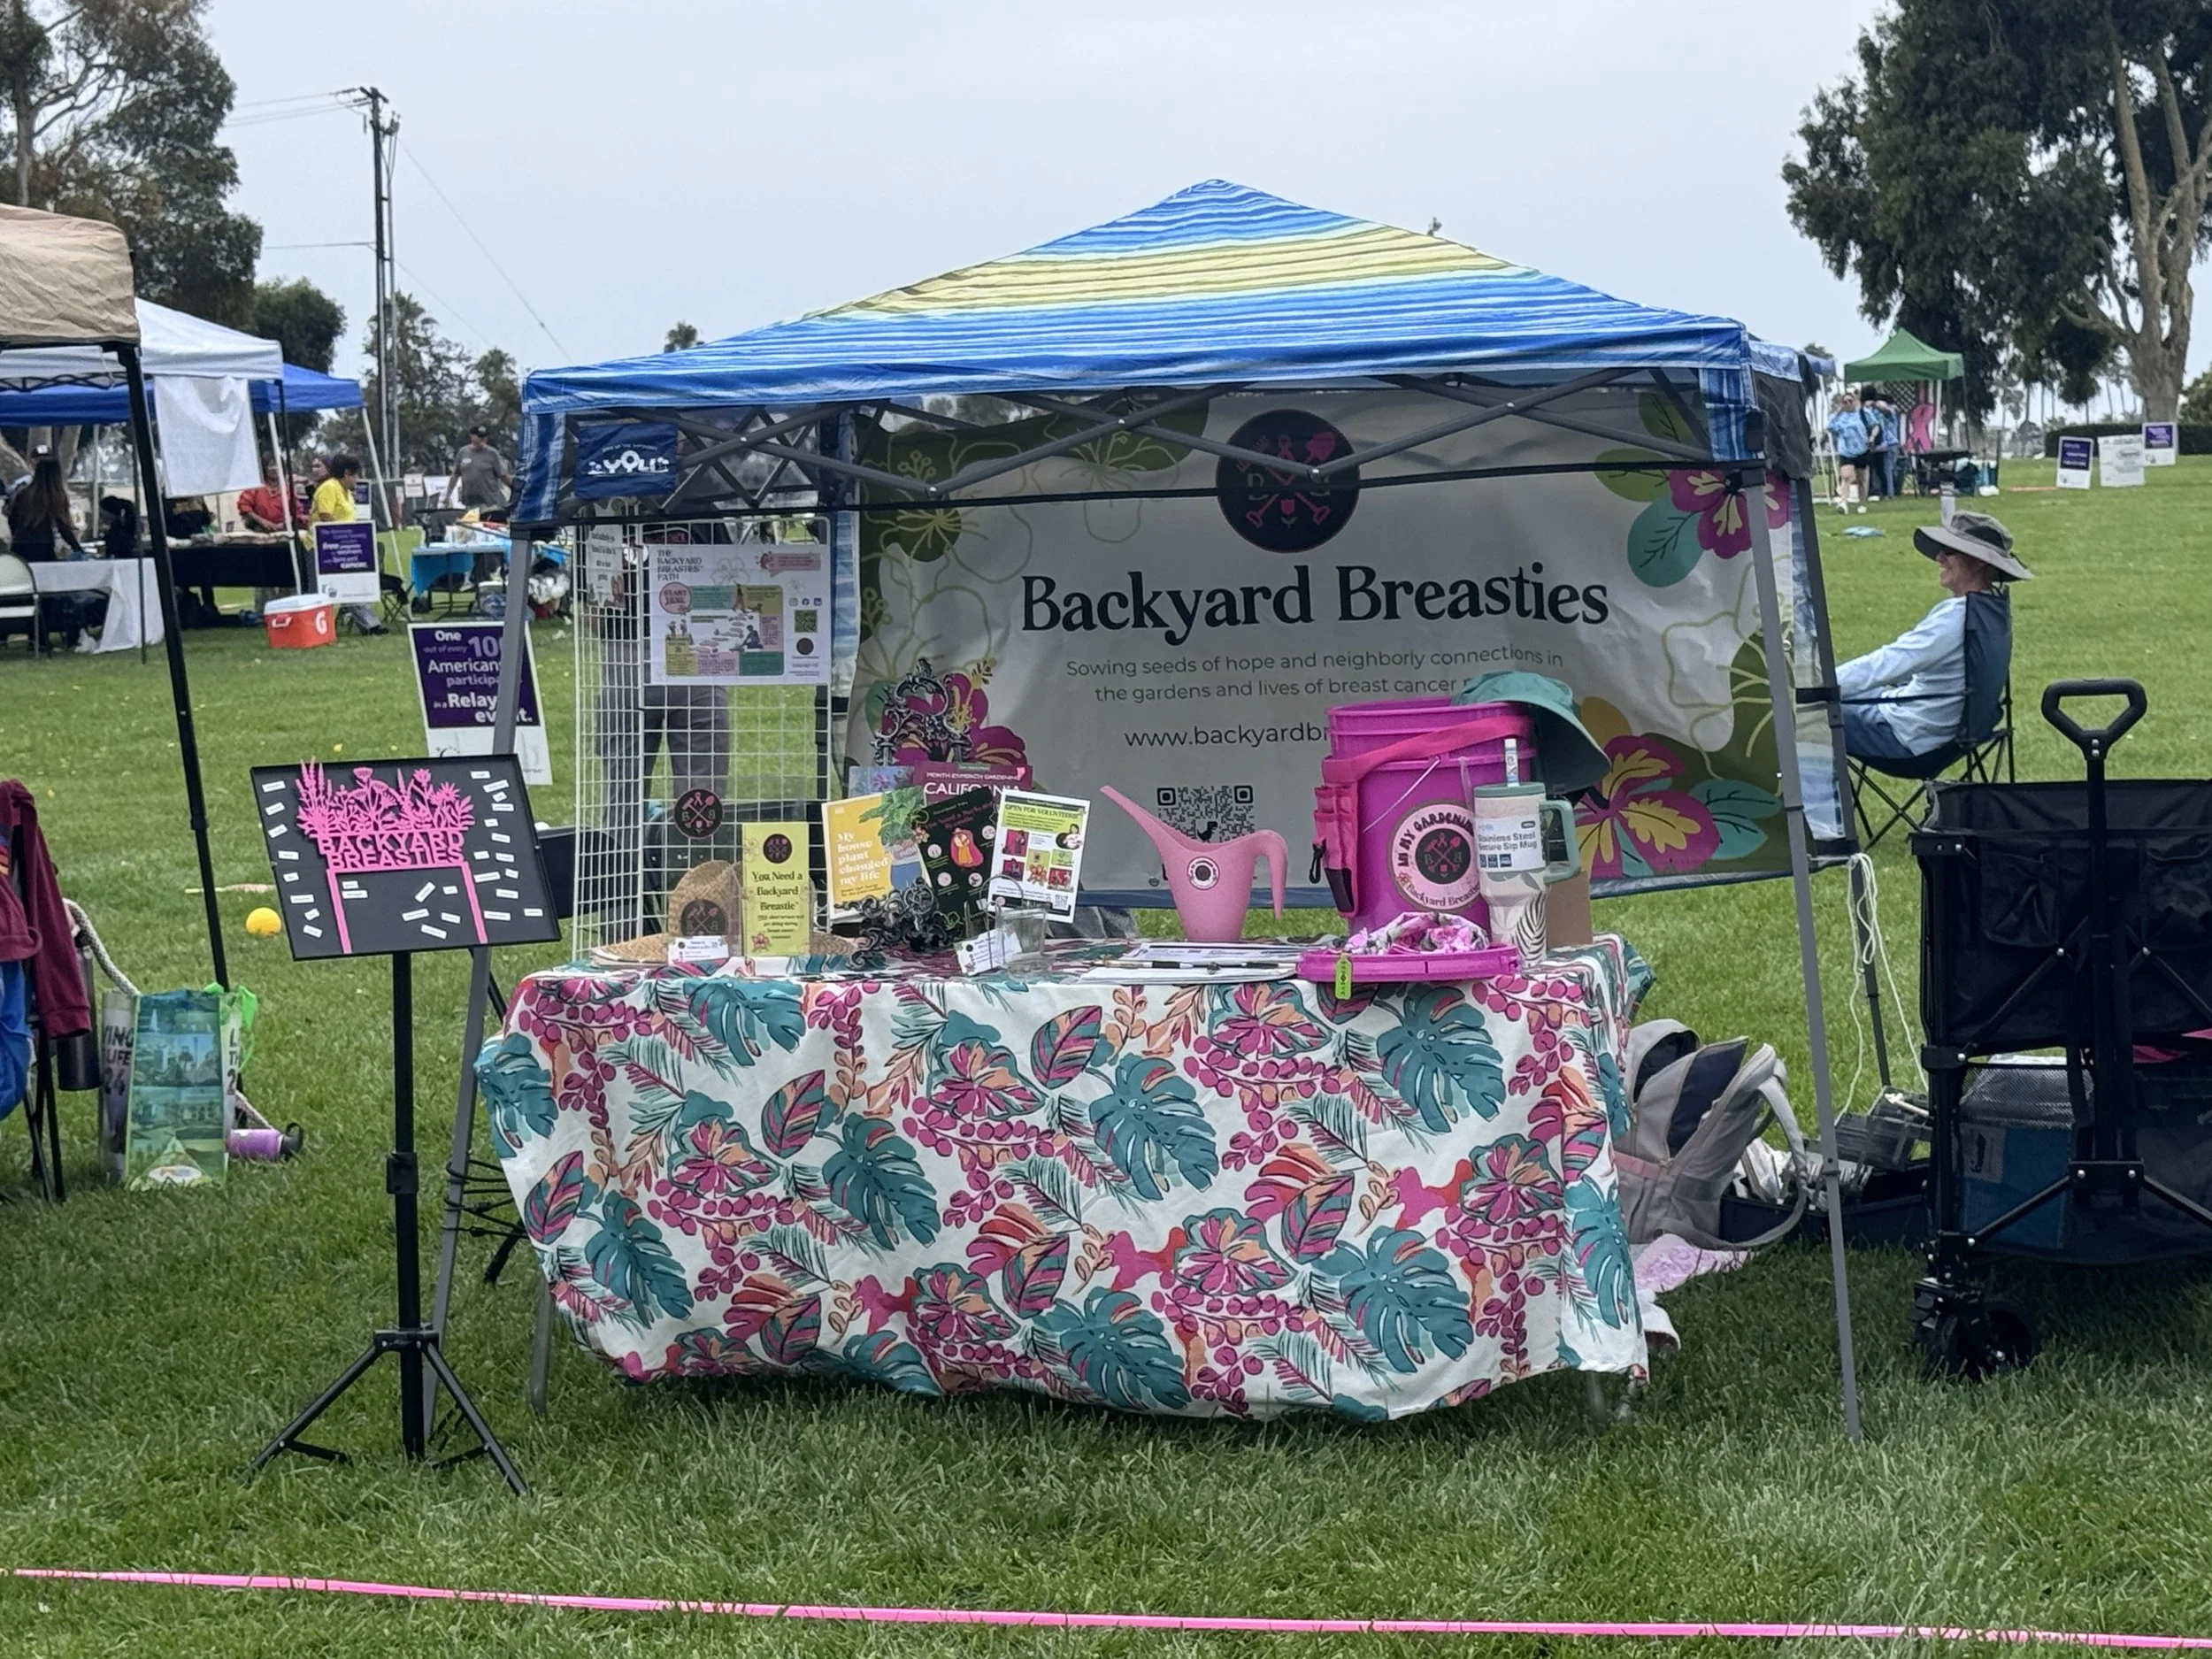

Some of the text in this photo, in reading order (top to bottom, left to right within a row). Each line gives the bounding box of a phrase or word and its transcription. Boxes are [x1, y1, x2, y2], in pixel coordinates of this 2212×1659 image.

[1021, 561, 1609, 646] Backyard Breasties
[434, 630, 462, 641] One
[468, 635, 503, 657] 10
[428, 657, 502, 674] American
[1066, 643, 1563, 678] Sowing seeds of hope and neighborly connections in
[1094, 686, 1127, 702] the
[1132, 684, 1211, 704] gardens
[1216, 680, 1254, 697] and
[1258, 680, 1300, 695] lives
[1304, 678, 1324, 695] of
[1328, 675, 1388, 694] breast
[1394, 678, 1457, 693] cancer
[447, 693, 497, 711] Relay
[318, 830, 465, 855] BACKYARD
[1512, 831, 1536, 841] Steel
[1519, 840, 1538, 849] Mug
[326, 847, 465, 869] BREASTIES
[838, 849, 870, 865] plant
[839, 856, 888, 875] changed
[752, 871, 771, 882] You
[772, 870, 795, 880] Need
[840, 870, 881, 886] my life
[757, 885, 799, 898] Backyard
